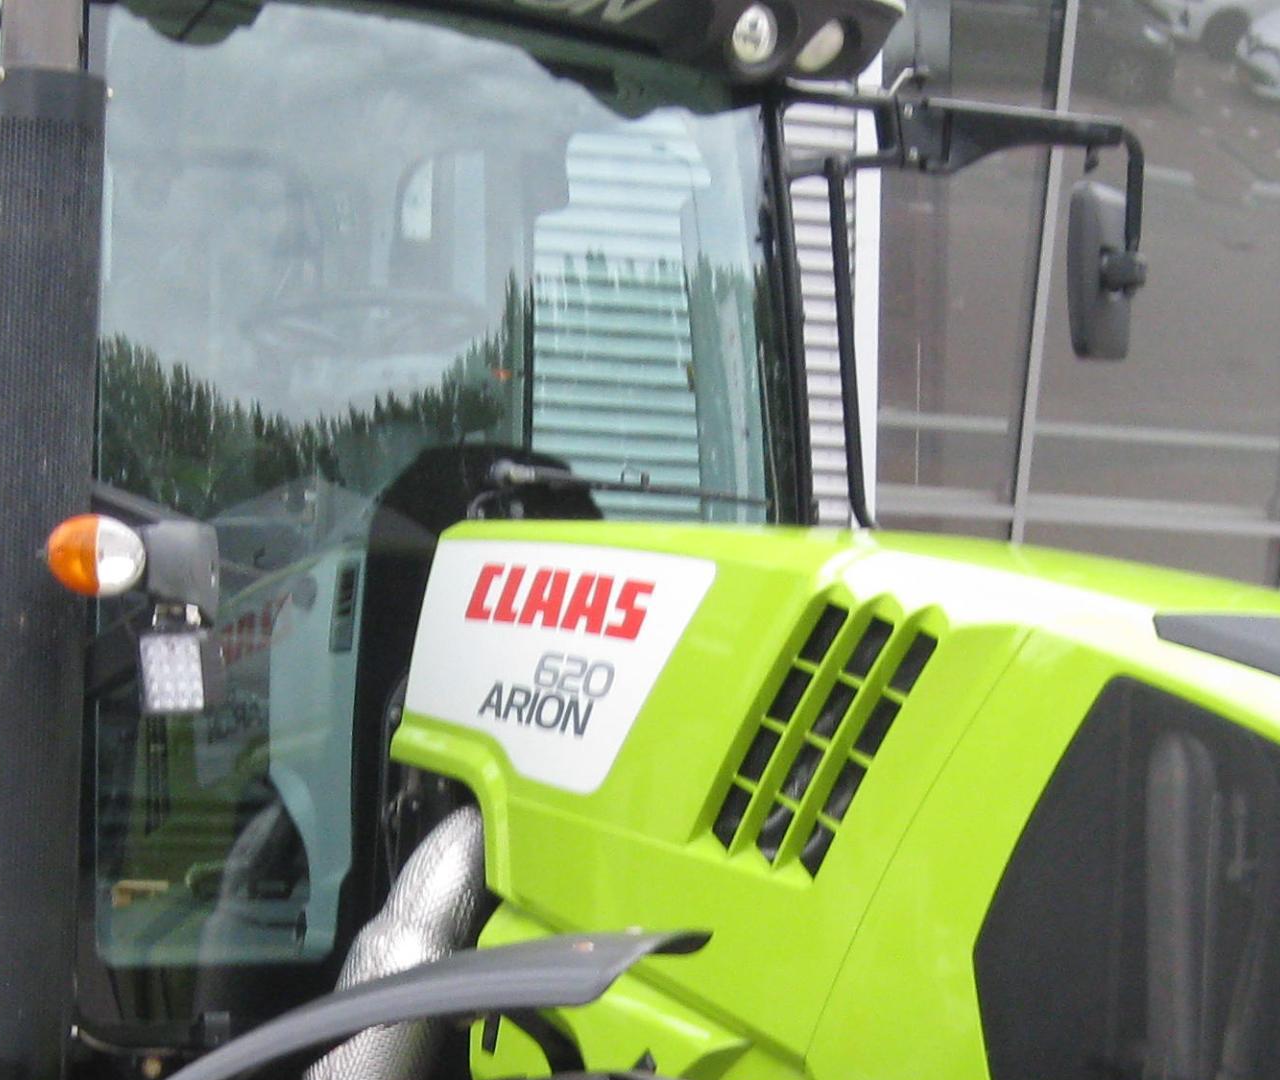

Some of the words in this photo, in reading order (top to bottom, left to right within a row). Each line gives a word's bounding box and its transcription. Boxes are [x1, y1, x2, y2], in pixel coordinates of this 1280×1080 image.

[465, 563, 656, 640] CLAAS
[534, 652, 614, 699] 620
[478, 682, 593, 738] ARION
